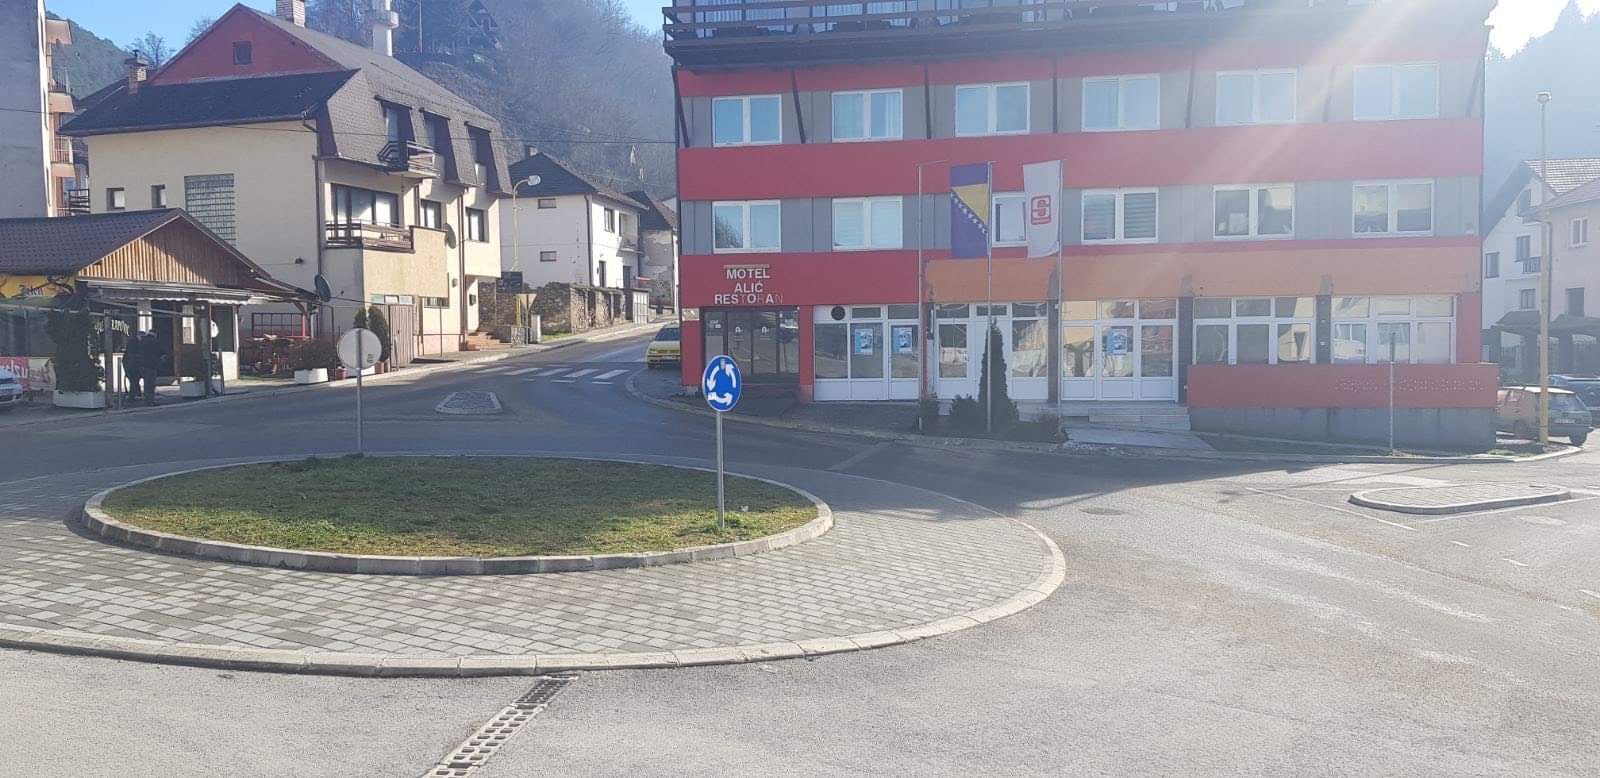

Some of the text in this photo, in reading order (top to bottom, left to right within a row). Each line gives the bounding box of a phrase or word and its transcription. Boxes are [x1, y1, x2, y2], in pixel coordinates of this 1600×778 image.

[726, 268, 770, 280] MOTEL
[734, 279, 764, 294] ALIĆ
[714, 293, 784, 305] RESTORAN
